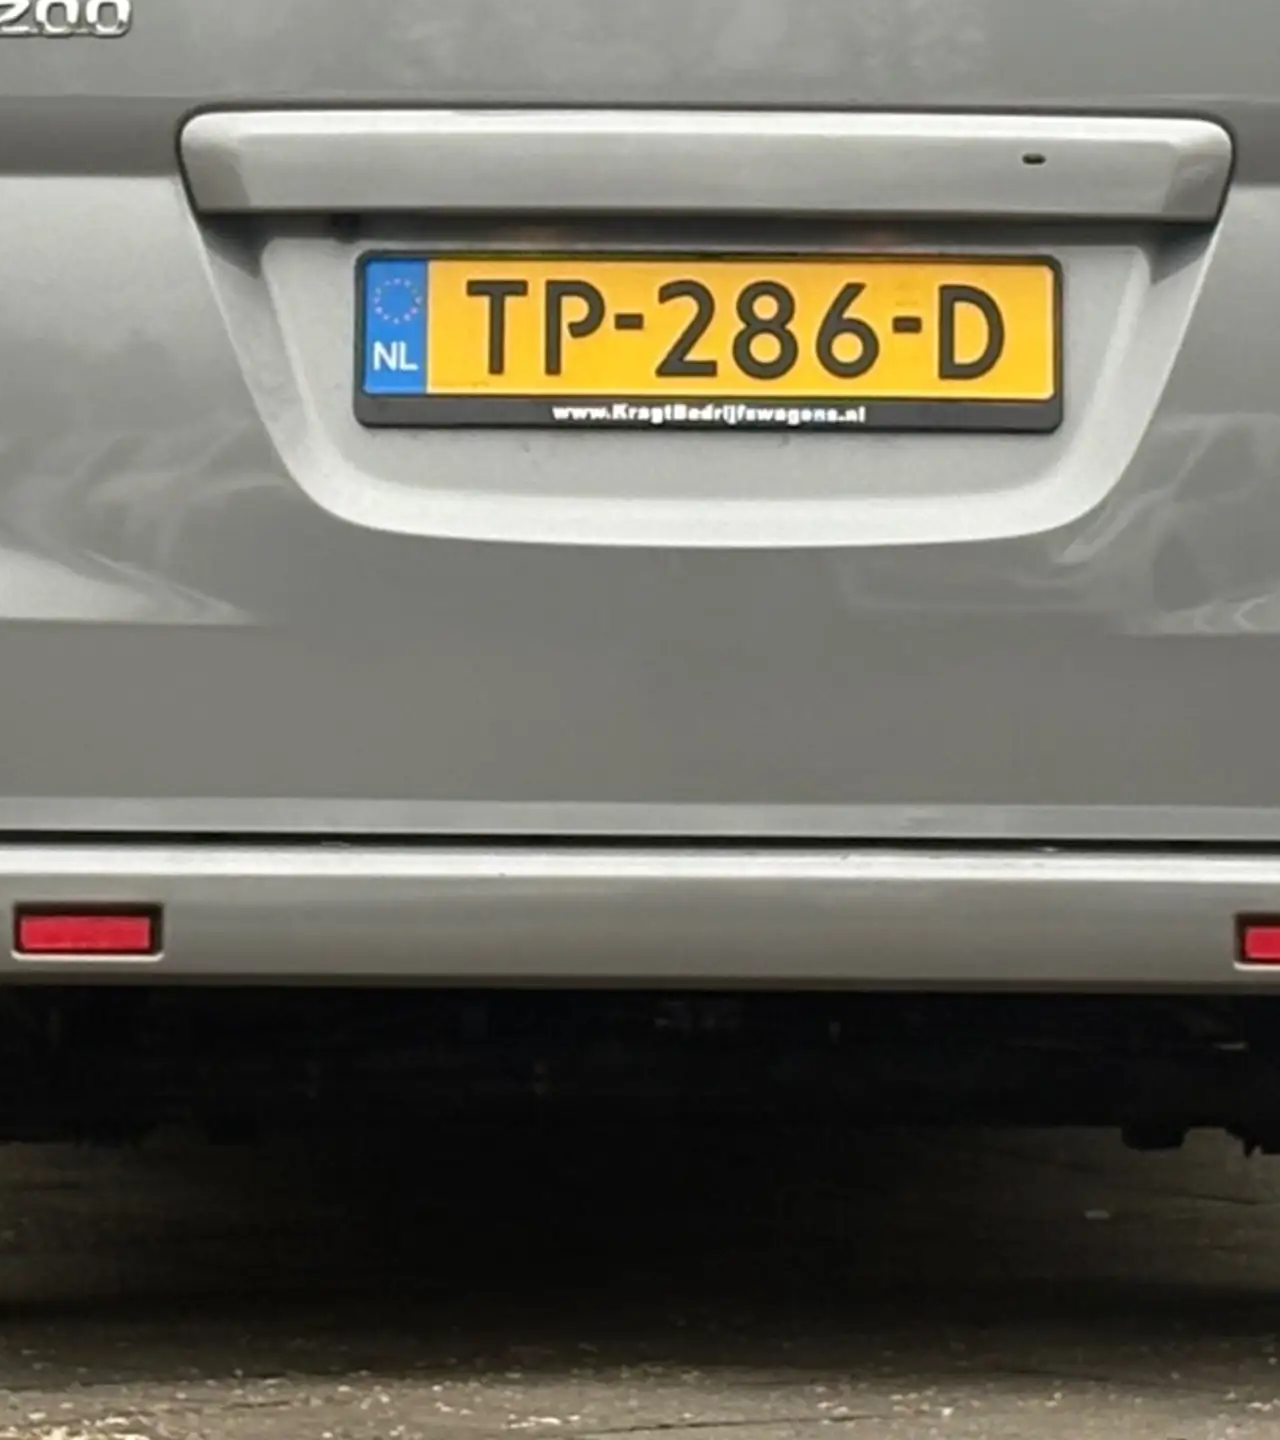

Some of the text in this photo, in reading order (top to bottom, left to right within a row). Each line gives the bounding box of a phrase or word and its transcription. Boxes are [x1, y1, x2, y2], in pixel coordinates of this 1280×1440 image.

[466, 279, 1005, 380] TP-286-D
[372, 342, 418, 372] NL
[552, 402, 867, 424] www.KragtBedrijfswagens.nl
